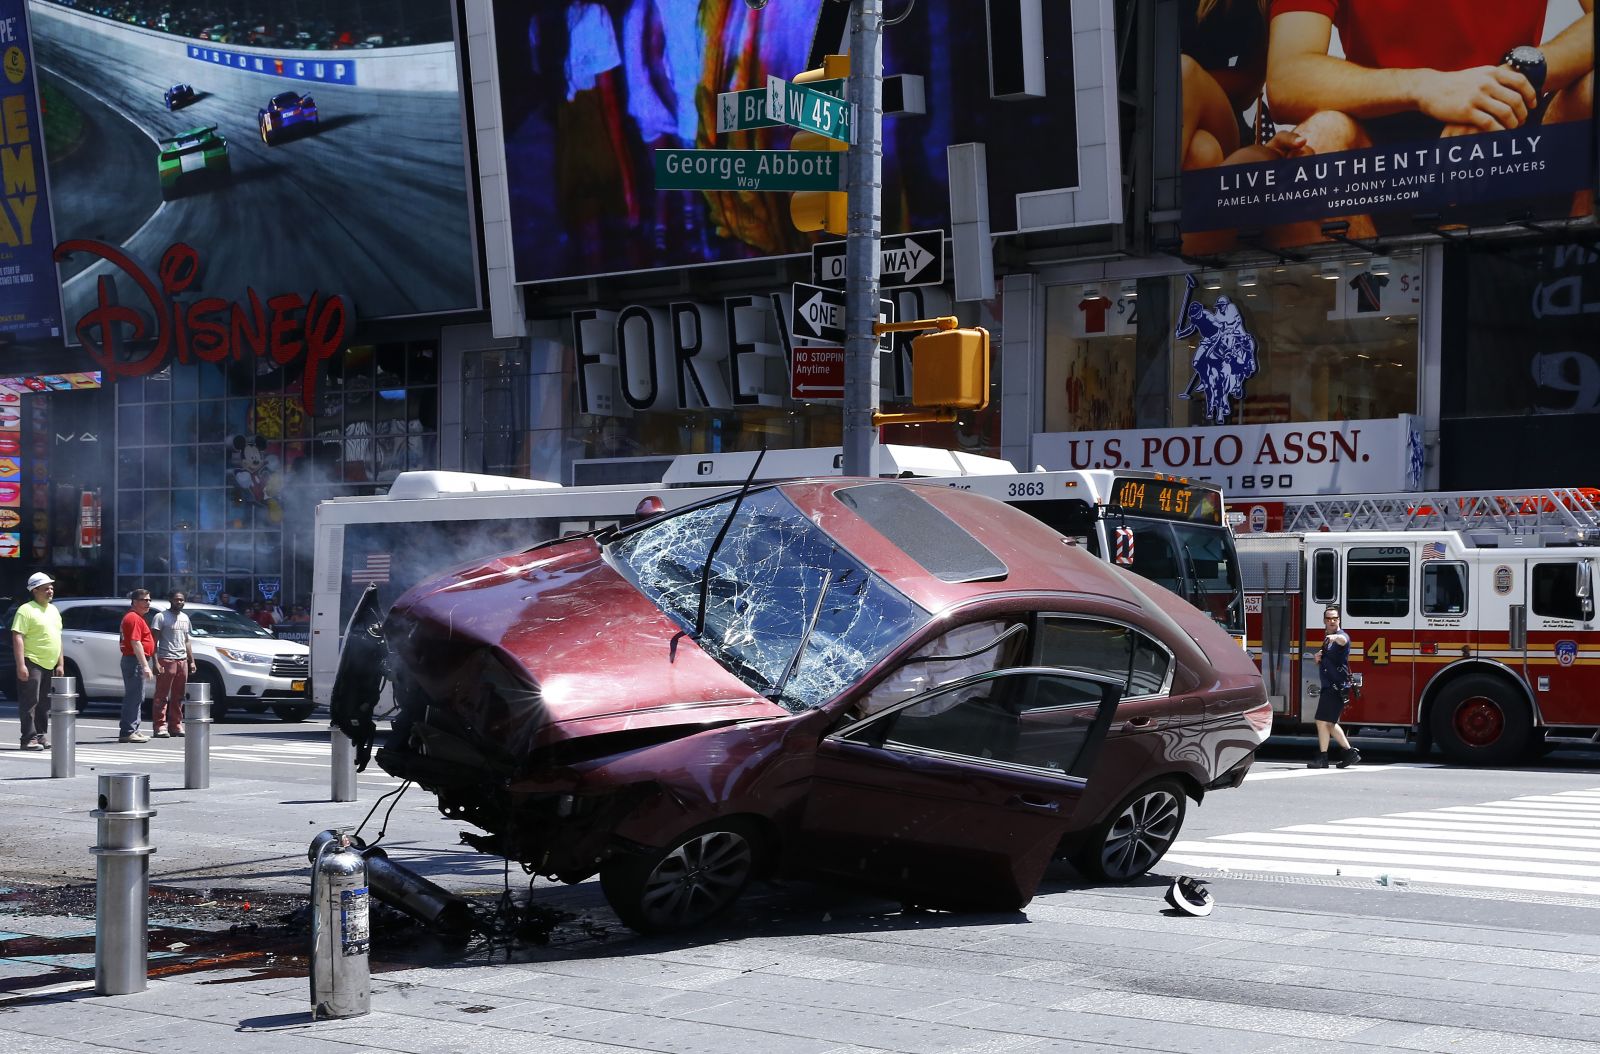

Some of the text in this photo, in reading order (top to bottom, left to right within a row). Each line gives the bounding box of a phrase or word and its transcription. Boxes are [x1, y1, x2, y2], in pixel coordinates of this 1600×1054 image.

[192, 48, 346, 80] PISTON CUP
[788, 89, 804, 122] W
[812, 98, 832, 131] 45
[838, 105, 849, 127] St
[666, 153, 832, 179] George Abbott
[1219, 135, 1542, 191] LIVE AUTHENTICALLY
[737, 176, 760, 190] Way
[1217, 194, 1260, 208] PAMELA
[1265, 186, 1327, 203] FLANAGAN
[1345, 179, 1386, 193] JONNY
[1391, 173, 1436, 188] LAVINE
[1450, 167, 1484, 181] POLO
[1490, 160, 1546, 176] PLAYERS
[1328, 191, 1420, 208] USPOLOASSN.COM
[883, 250, 922, 272] WAY
[809, 303, 837, 326] ONE
[796, 352, 844, 362] NO STOPPIN
[796, 364, 831, 376] Anytime
[1068, 429, 1370, 470] U.S. POLO ASSN.
[1008, 481, 1045, 497] 3863
[1227, 474, 1292, 489] 1890
[1159, 487, 1172, 512] 41
[1175, 489, 1192, 514] ST
[1367, 637, 1391, 665] 4
